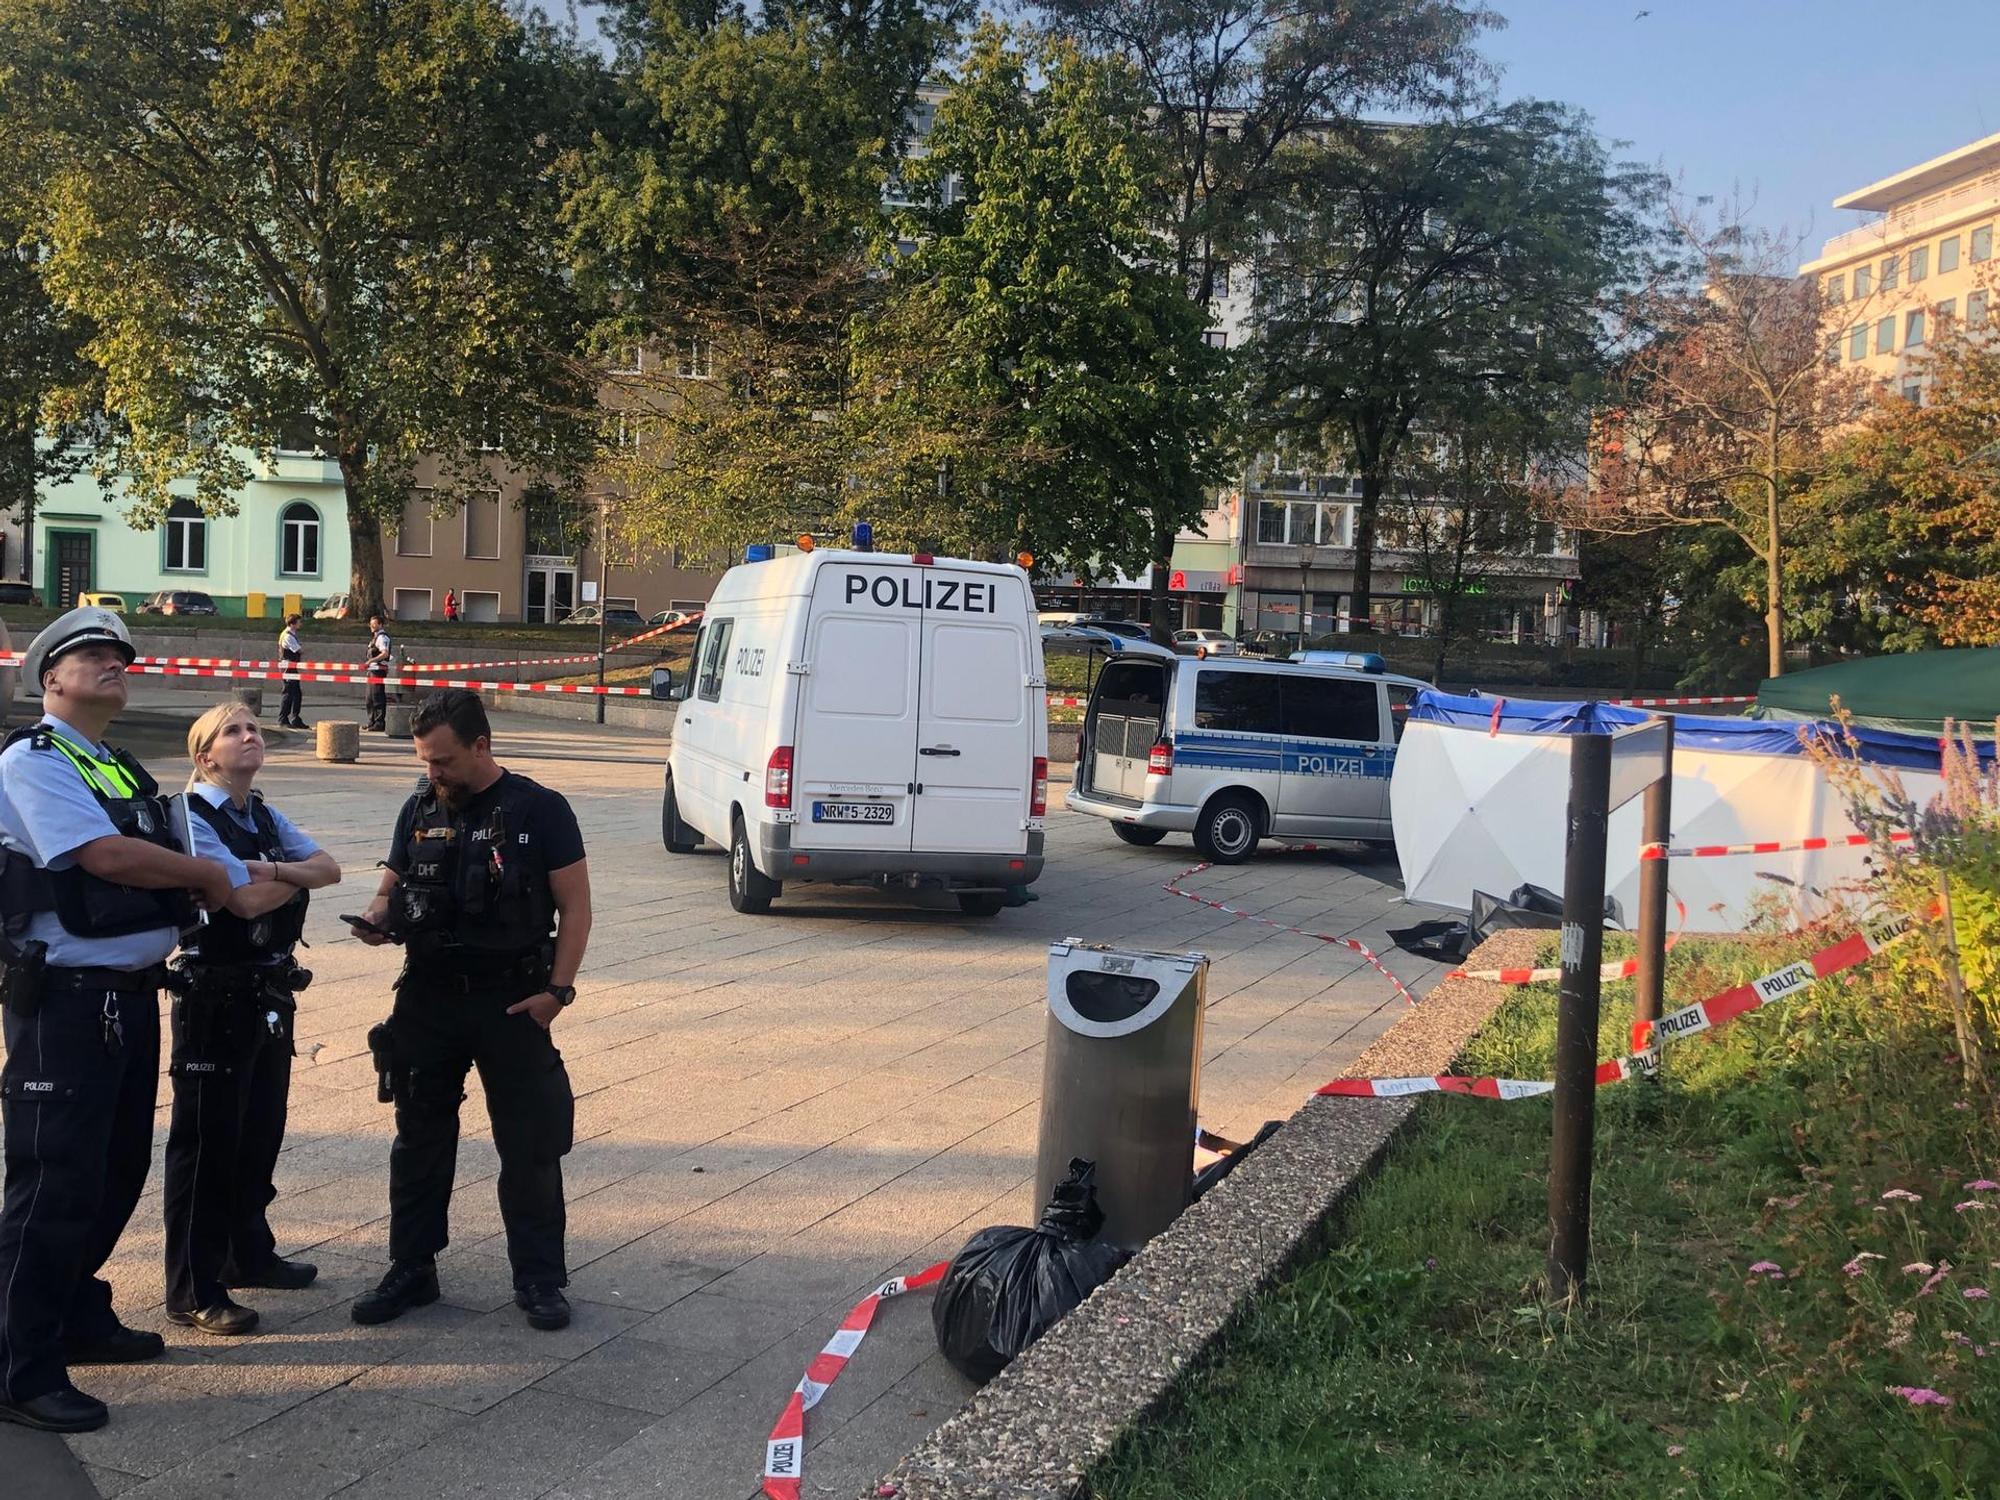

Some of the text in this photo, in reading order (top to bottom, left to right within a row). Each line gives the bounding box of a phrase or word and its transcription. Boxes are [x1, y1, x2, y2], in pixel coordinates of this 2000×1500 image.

[845, 574, 995, 613] POLIZEI
[736, 647, 767, 677] POLIZEI
[1298, 756, 1364, 776] POLIZEI
[822, 805, 892, 820] NRW 5-2329
[1761, 966, 1810, 996] POLIZI
[1659, 1009, 1701, 1037] POLIZEI
[186, 1062, 215, 1072] POLIZEI
[23, 1082, 53, 1092] POLIZEI
[772, 1442, 794, 1473] POLIZEI
